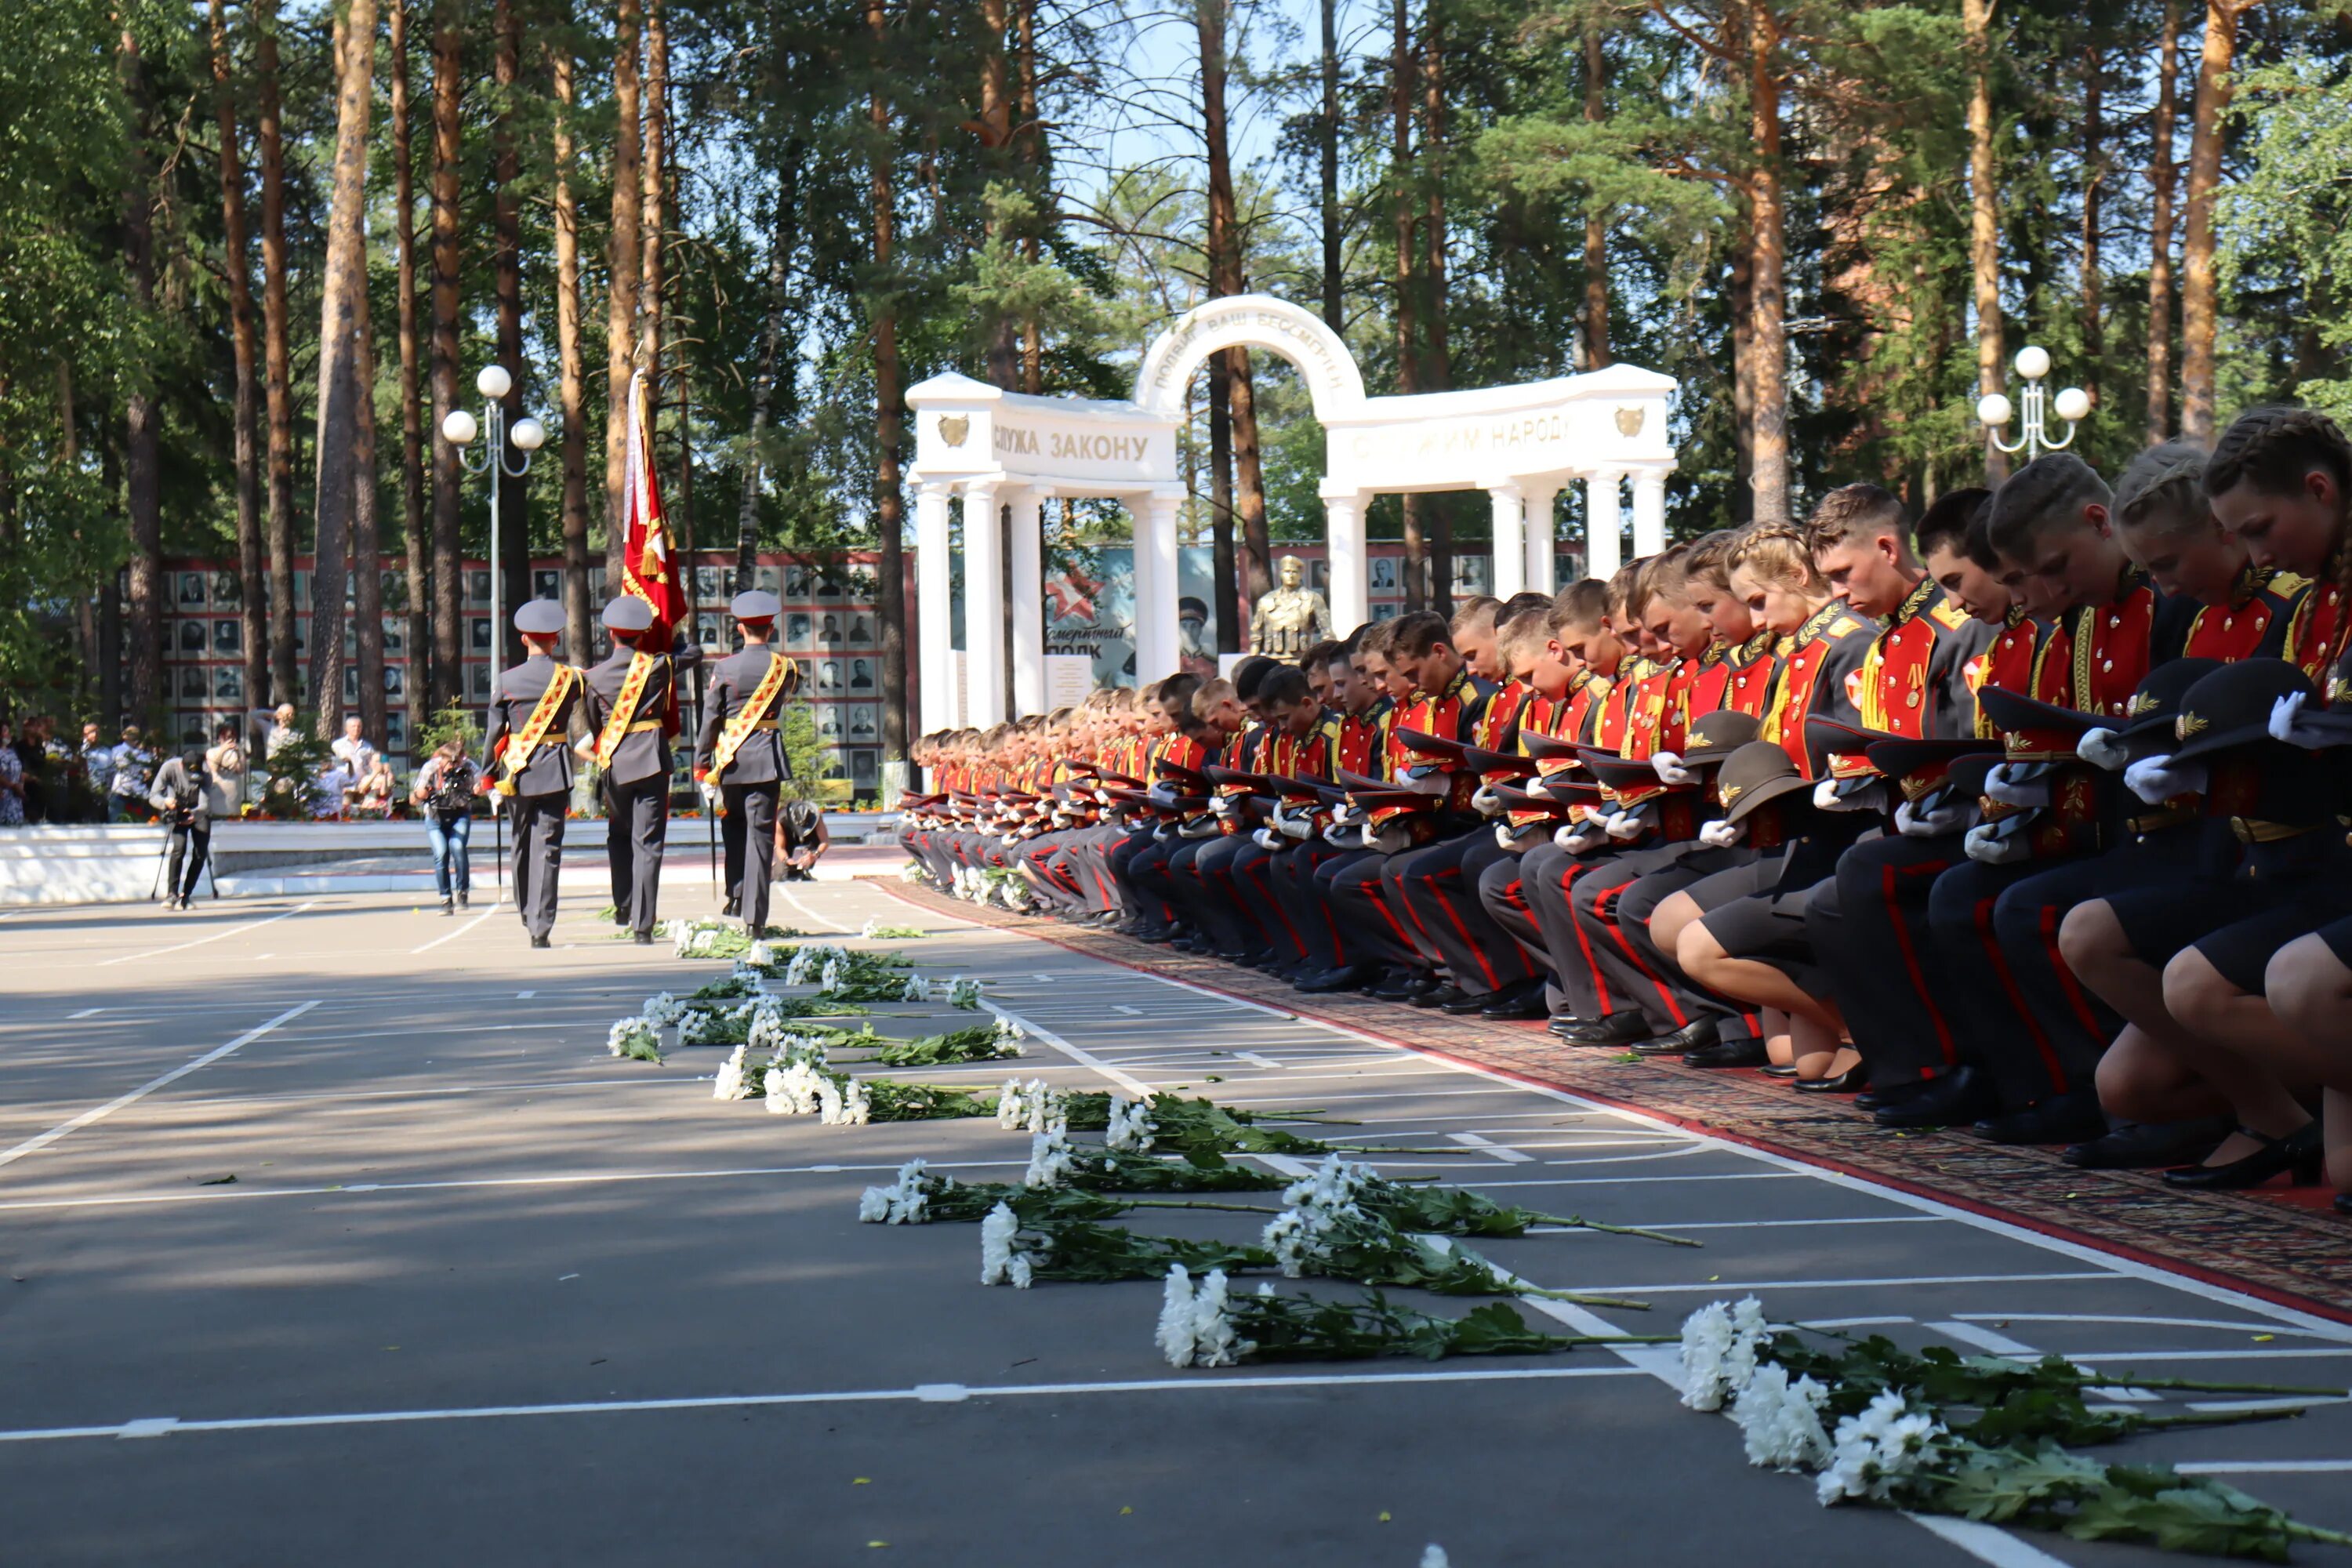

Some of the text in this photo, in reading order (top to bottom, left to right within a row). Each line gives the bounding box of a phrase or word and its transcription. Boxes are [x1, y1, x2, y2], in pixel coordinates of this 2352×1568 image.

[1207, 312, 1247, 332] ВАШ
[1257, 313, 1344, 389] БЕССМЕРТЕН
[993, 424, 1149, 462] СЛУЖА ЗАКОНУ
